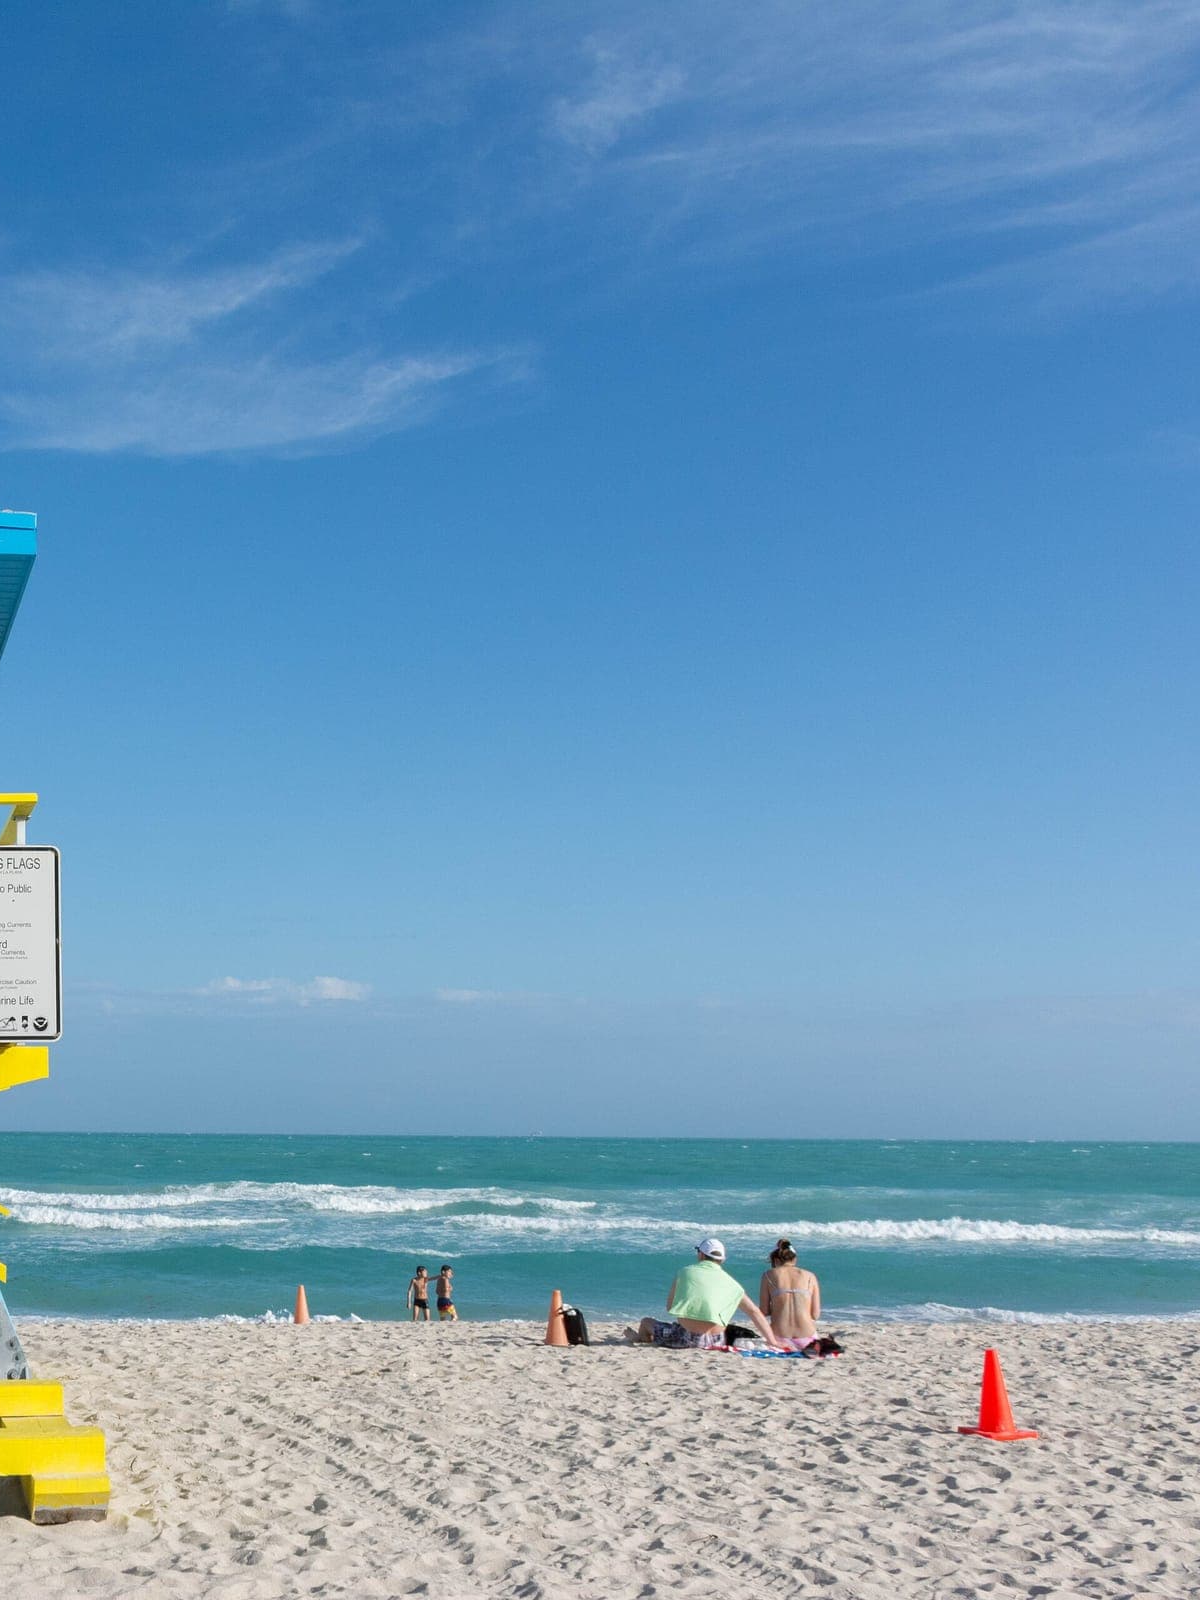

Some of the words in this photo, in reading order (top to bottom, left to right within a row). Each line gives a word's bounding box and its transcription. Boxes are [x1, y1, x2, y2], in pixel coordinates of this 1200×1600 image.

[6, 858, 41, 870] FLAGS
[7, 884, 32, 894] Public
[19, 996, 34, 1005] Life
